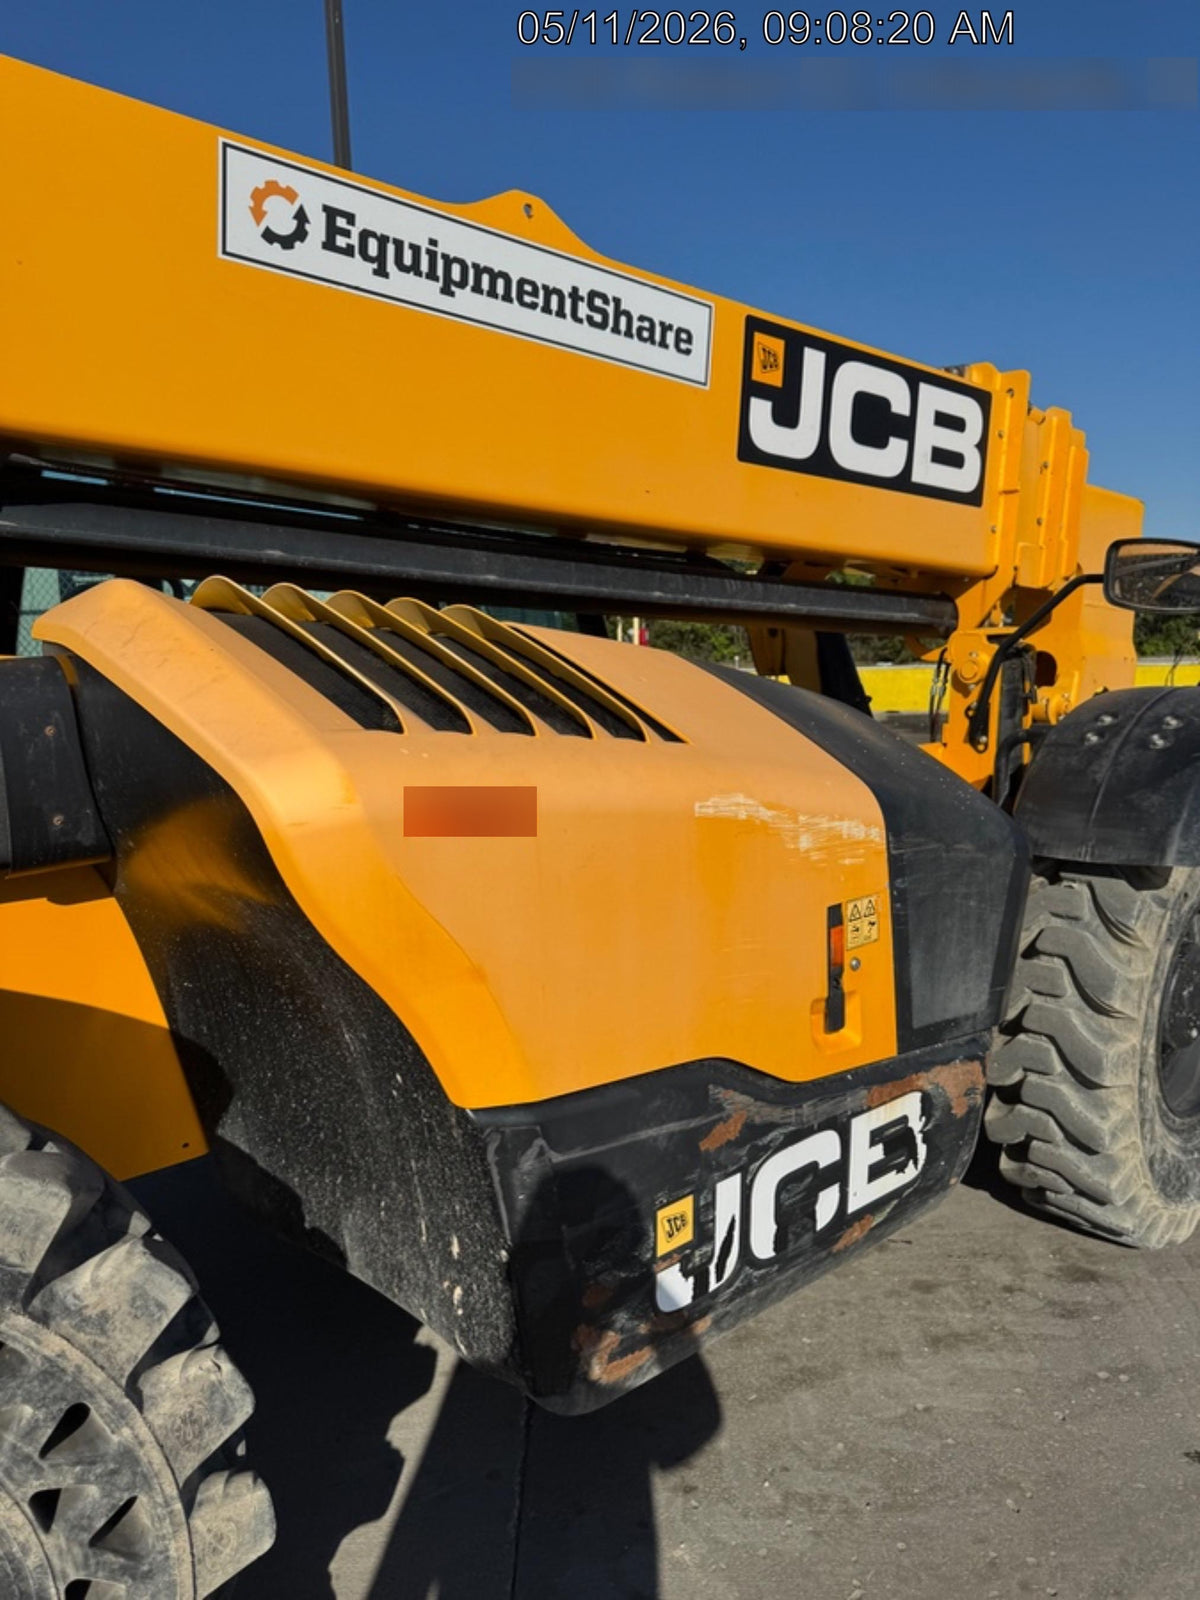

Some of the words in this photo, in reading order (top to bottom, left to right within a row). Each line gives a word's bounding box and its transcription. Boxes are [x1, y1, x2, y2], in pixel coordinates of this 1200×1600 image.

[321, 203, 693, 357] EquipmentShare
[748, 346, 984, 494] JCB
[655, 1091, 927, 1313] JCB
